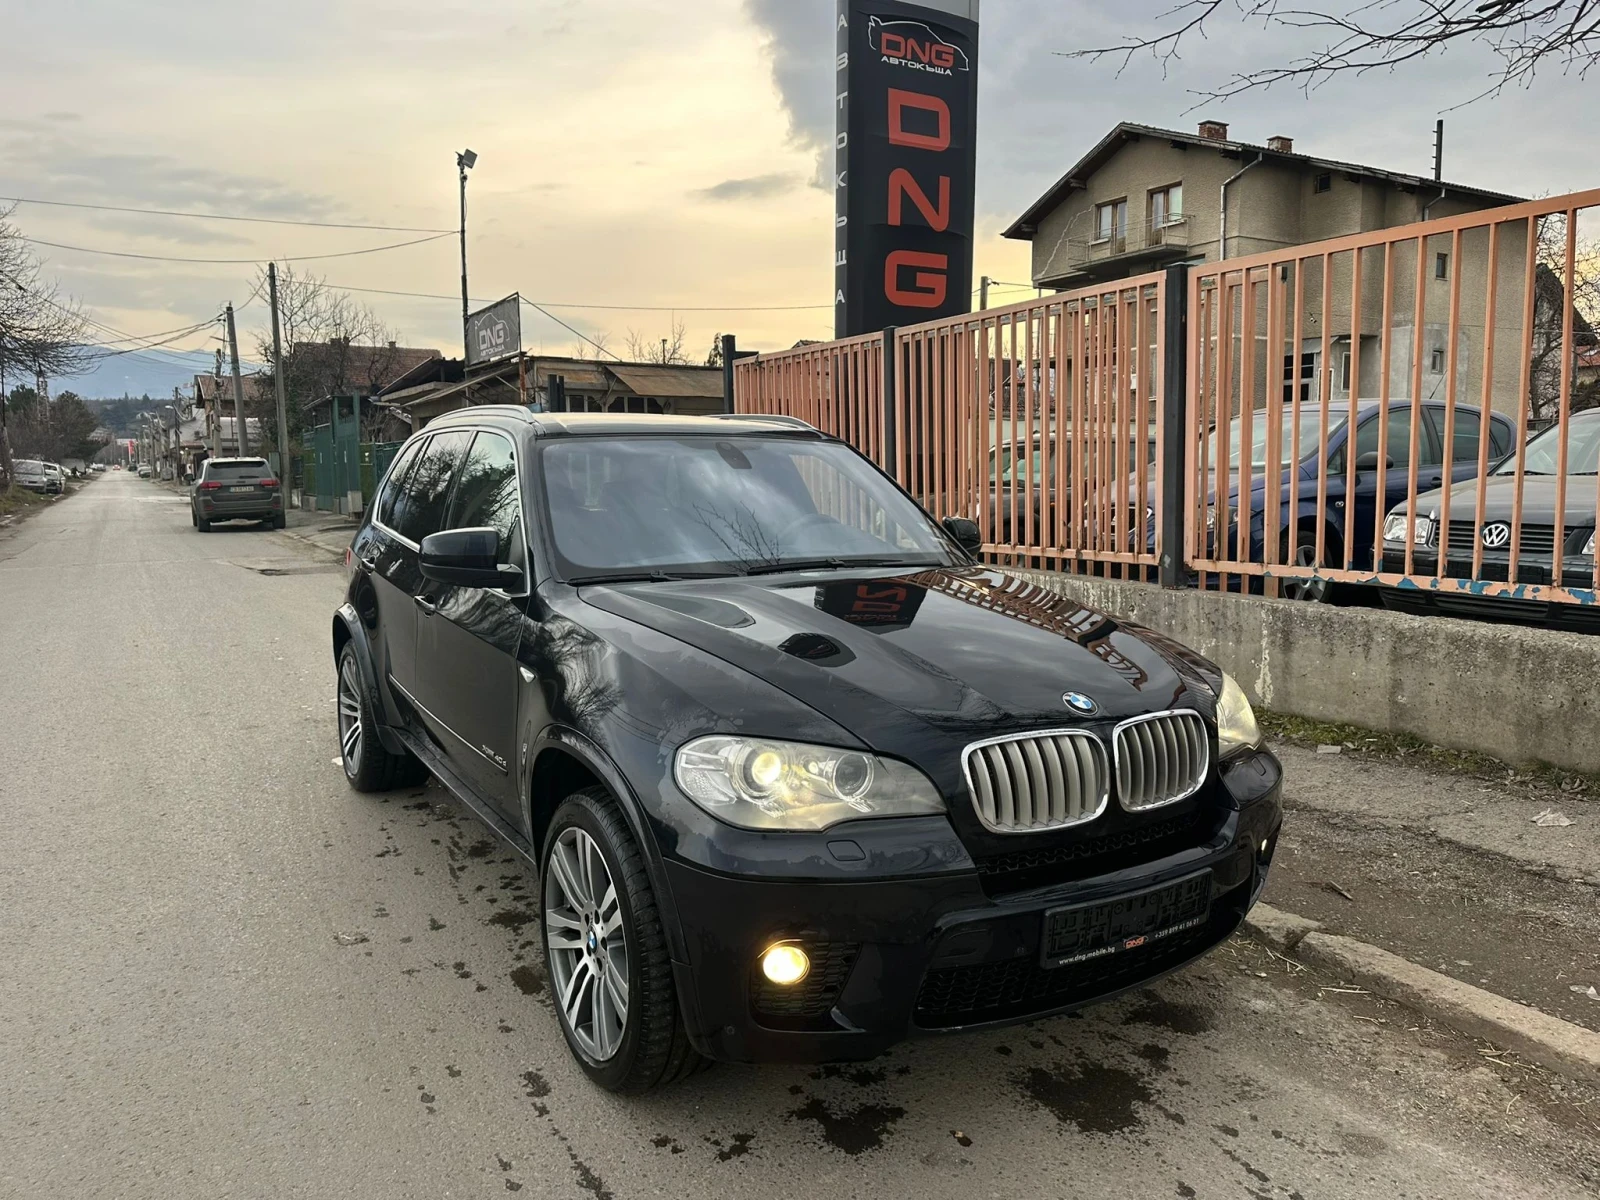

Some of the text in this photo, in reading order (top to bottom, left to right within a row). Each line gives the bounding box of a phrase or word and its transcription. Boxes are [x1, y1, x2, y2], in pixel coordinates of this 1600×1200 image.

[881, 32, 954, 68] DNG
[884, 87, 951, 309] DNG
[479, 323, 504, 350] DNG
[1059, 946, 1115, 965] www.dng.mobile.bg
[1155, 929, 1169, 938] +359
